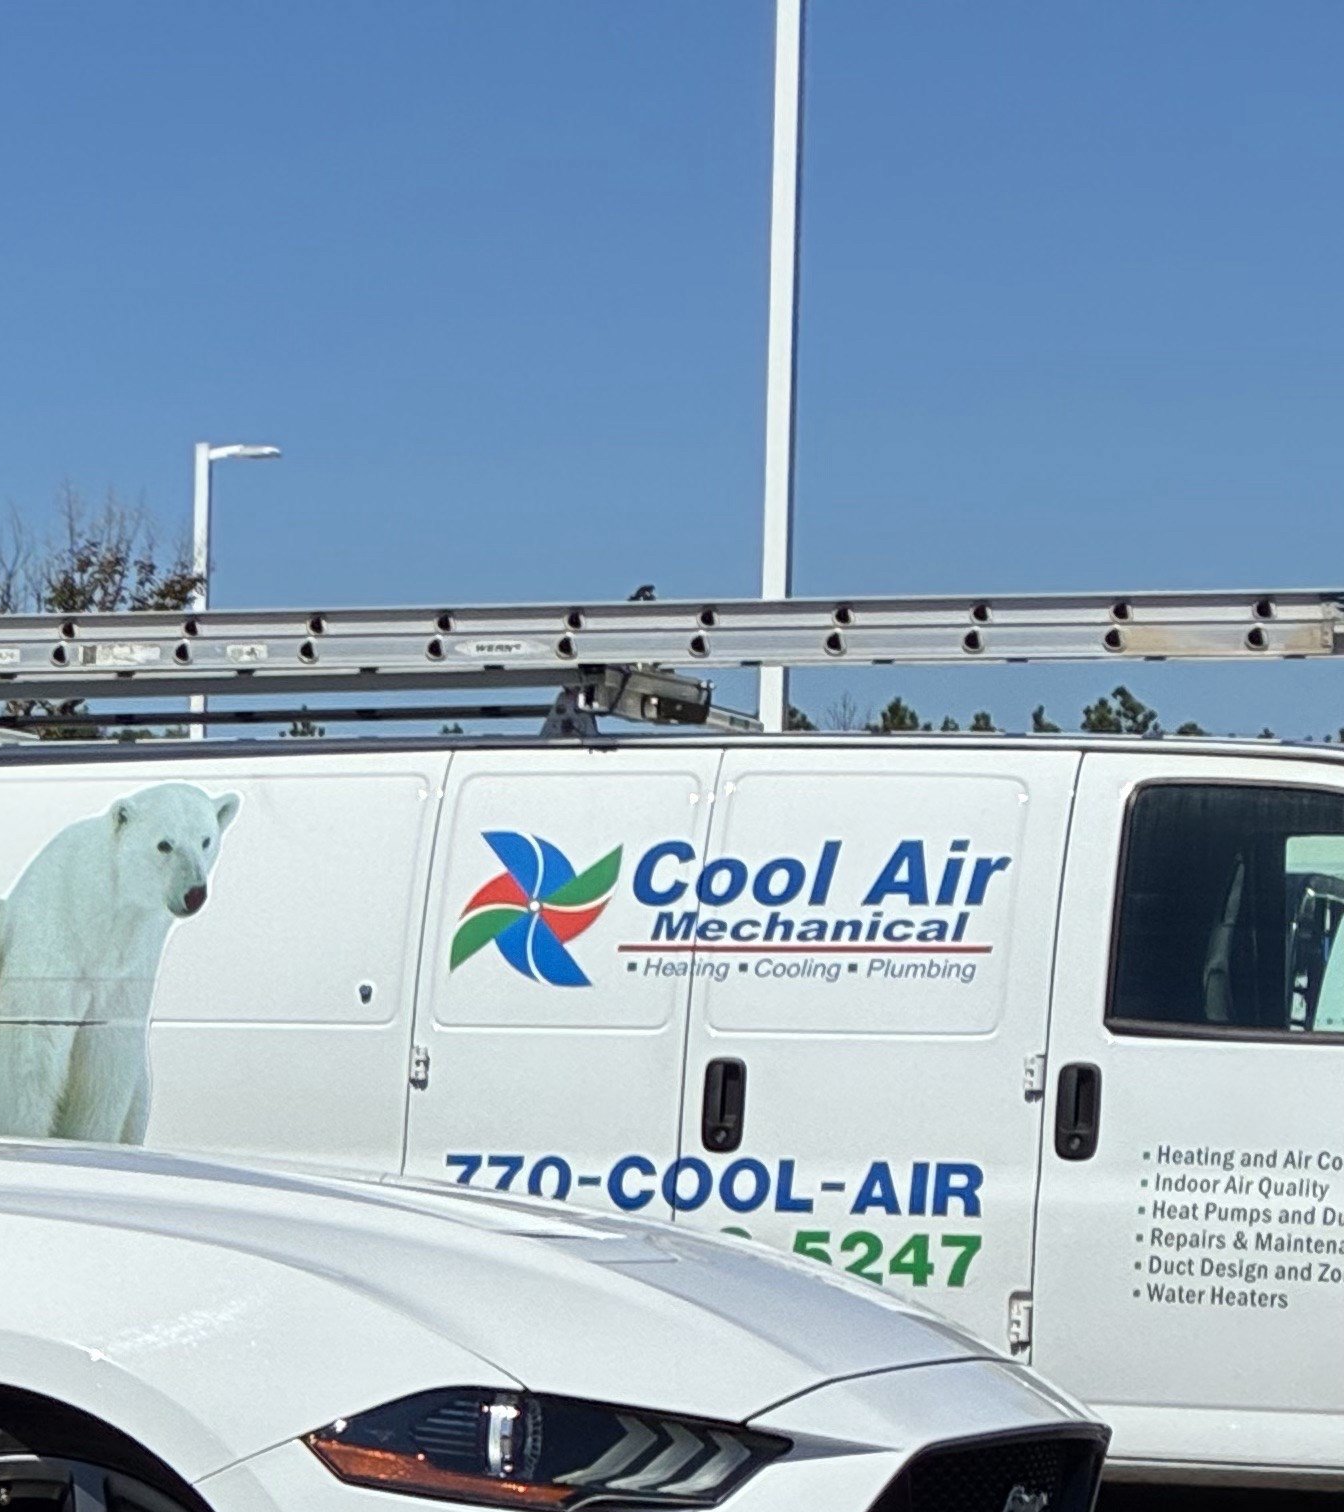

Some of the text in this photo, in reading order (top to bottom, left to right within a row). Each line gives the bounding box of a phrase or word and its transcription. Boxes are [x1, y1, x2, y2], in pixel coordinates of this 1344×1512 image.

[632, 840, 1011, 906] Cool Air
[650, 911, 970, 943] Mechanical
[643, 958, 977, 983] Heating Cooling Plumbing
[1157, 1145, 1235, 1171] Heating
[1240, 1150, 1278, 1168] and
[1282, 1150, 1312, 1170] Air
[445, 1154, 984, 1217] 770-COOL-AIR
[1154, 1172, 1330, 1202] Indoor Air Quality
[1152, 1200, 1199, 1221] Heat
[1204, 1202, 1272, 1227] Pumps
[1278, 1206, 1316, 1225] and
[1150, 1227, 1226, 1251] Repairs
[1232, 1231, 1248, 1250] &
[1148, 1255, 1195, 1276] Duct
[1200, 1257, 1269, 1283] Design
[1274, 1262, 1312, 1281] and
[1146, 1282, 1289, 1309] Water Heaters
